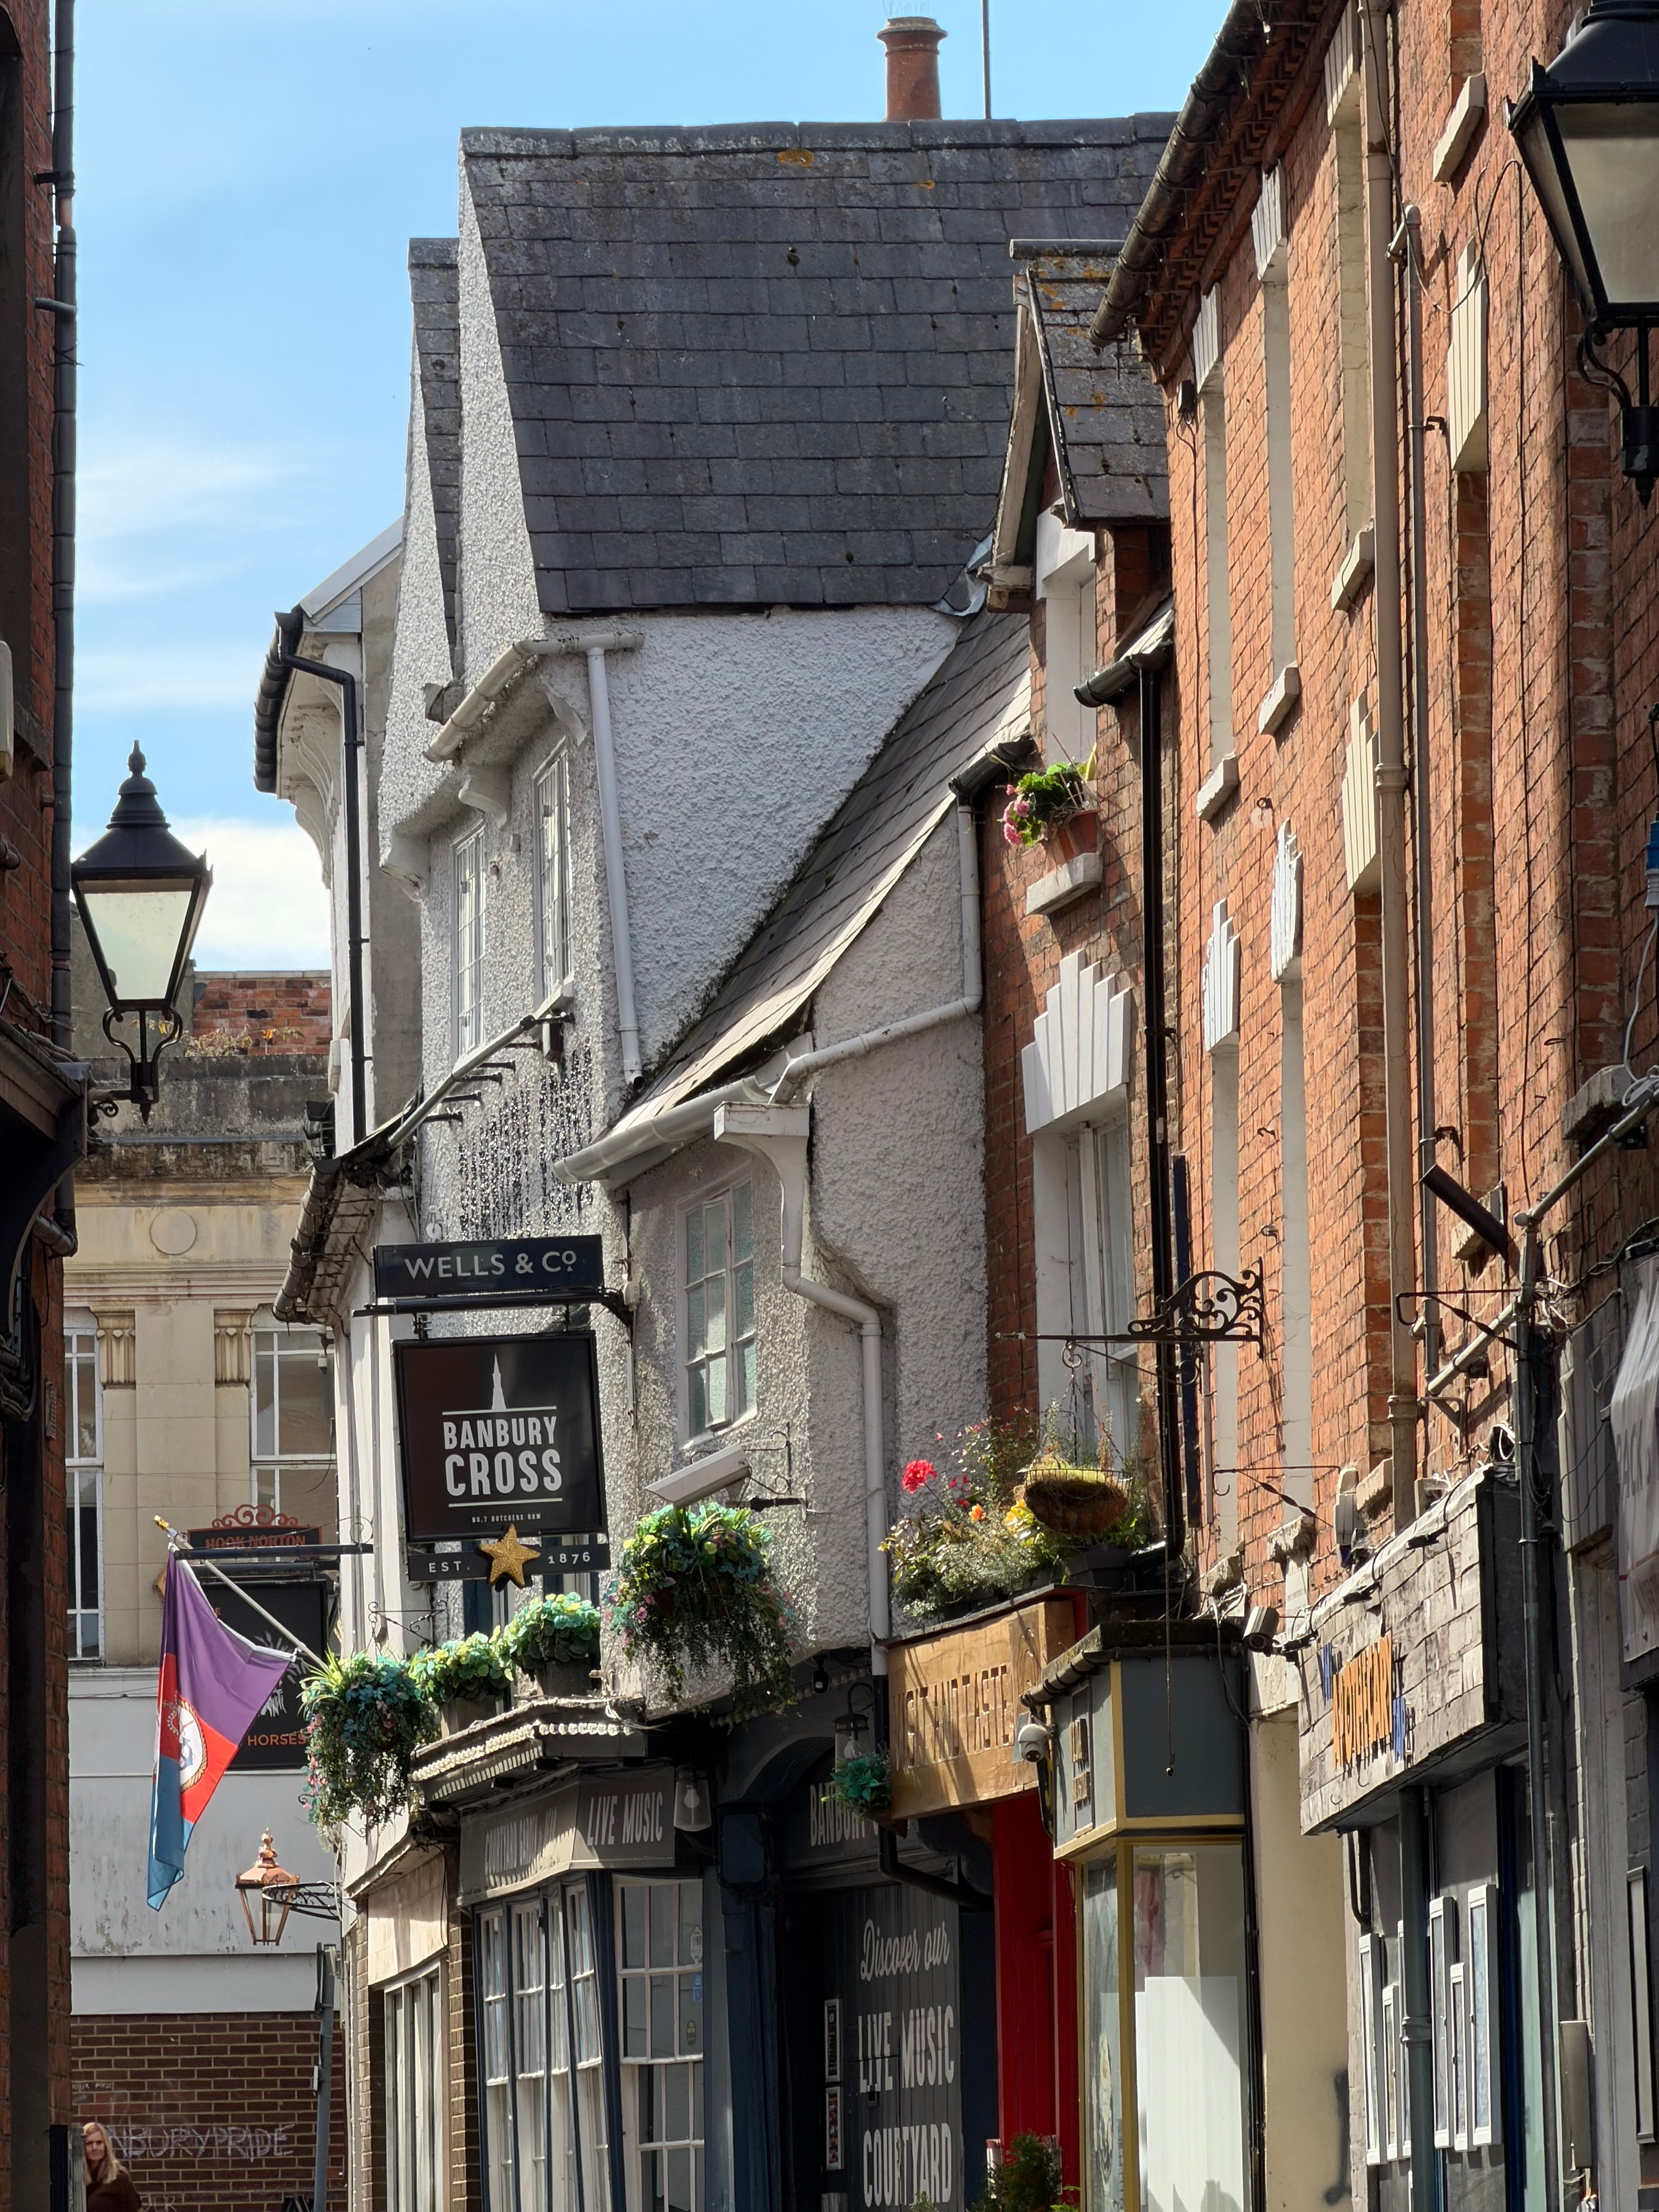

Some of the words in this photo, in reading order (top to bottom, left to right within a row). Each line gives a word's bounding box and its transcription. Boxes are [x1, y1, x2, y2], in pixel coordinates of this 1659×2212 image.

[404, 1254, 505, 1279] WELLS
[515, 1253, 534, 1274] &
[443, 1416, 556, 1450] BANBURY
[445, 1449, 562, 1497] CROSS
[205, 1536, 244, 1548] HOOK
[429, 1562, 470, 1573] EST.
[548, 1552, 590, 1565] 1876
[933, 1679, 960, 1763] AND
[961, 1665, 1010, 1755] TASTE
[1333, 1630, 1392, 1770] APOTHECARY
[248, 1734, 306, 1746] HORSES
[1393, 1696, 1406, 1763] TAP
[588, 1795, 618, 1846] LIVE
[622, 1791, 663, 1843] MUSIC
[861, 1919, 921, 1982] Discover
[925, 1920, 950, 1971] our
[858, 2012, 893, 2094] LIVE
[902, 2005, 955, 2089] MUSIC
[863, 2123, 952, 2208] COURTYARD
